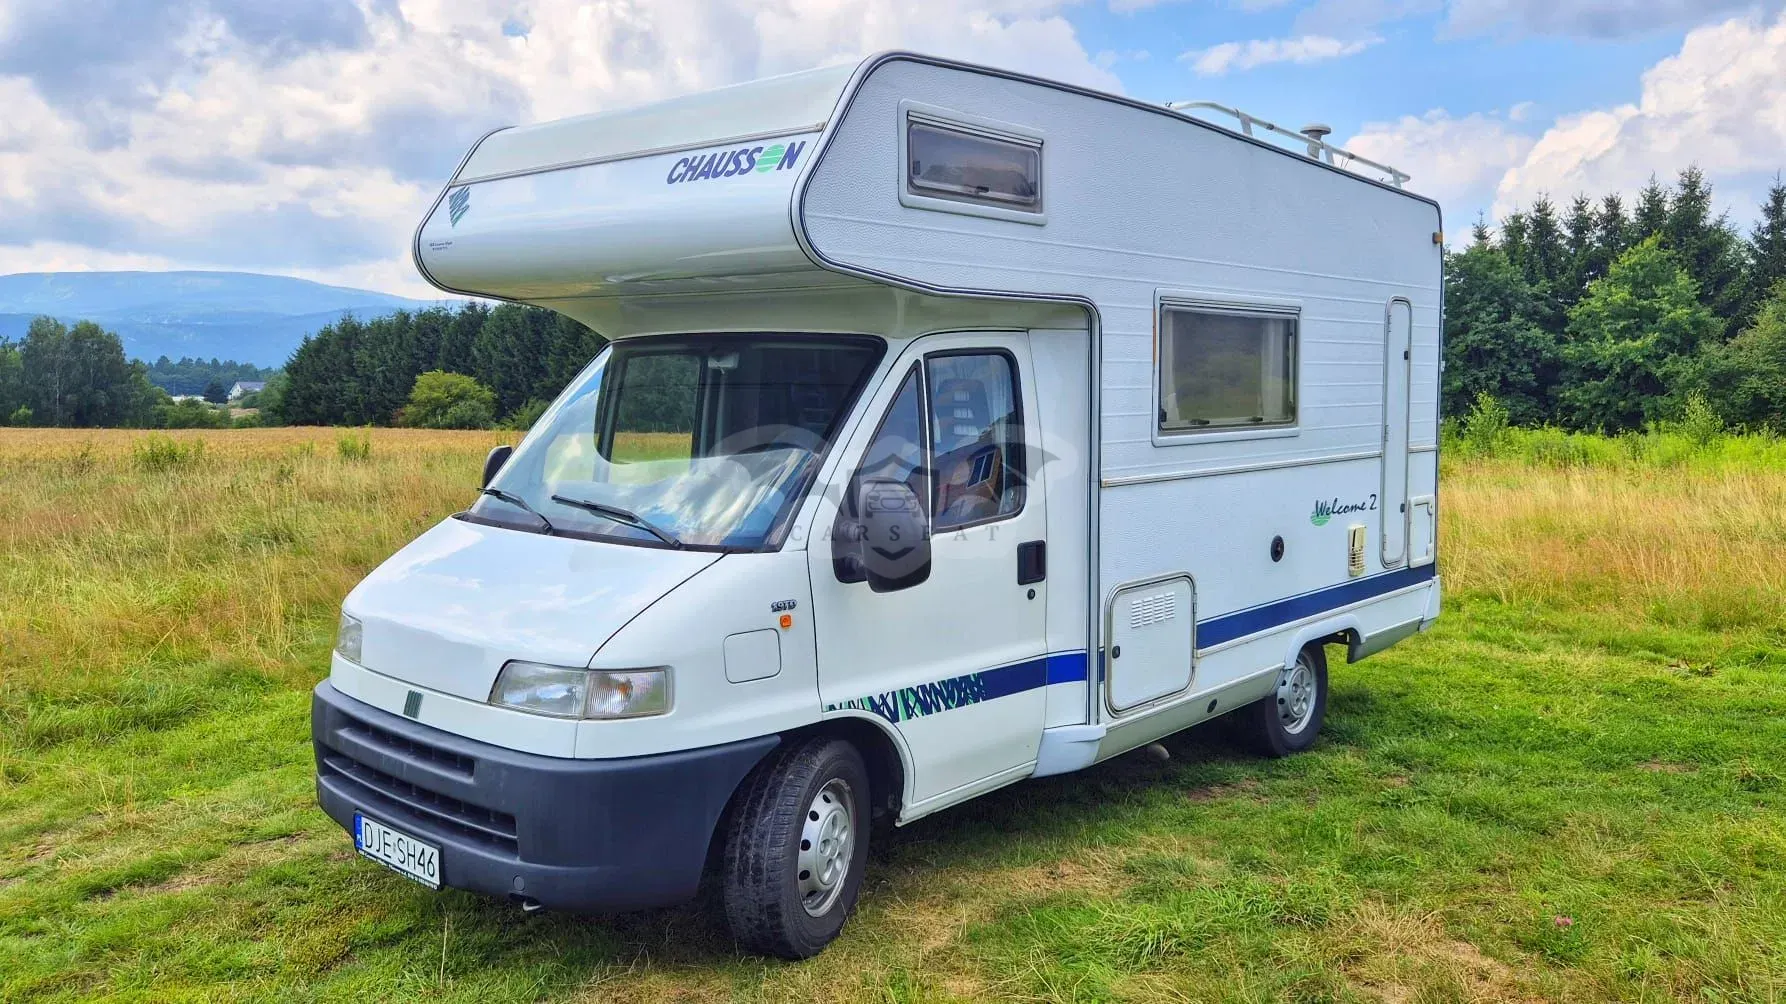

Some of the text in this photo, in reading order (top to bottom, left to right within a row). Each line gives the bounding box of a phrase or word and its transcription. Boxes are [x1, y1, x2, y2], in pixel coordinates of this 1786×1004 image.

[667, 141, 806, 184] CHAUSSON
[1315, 494, 1377, 516] Welcome 2
